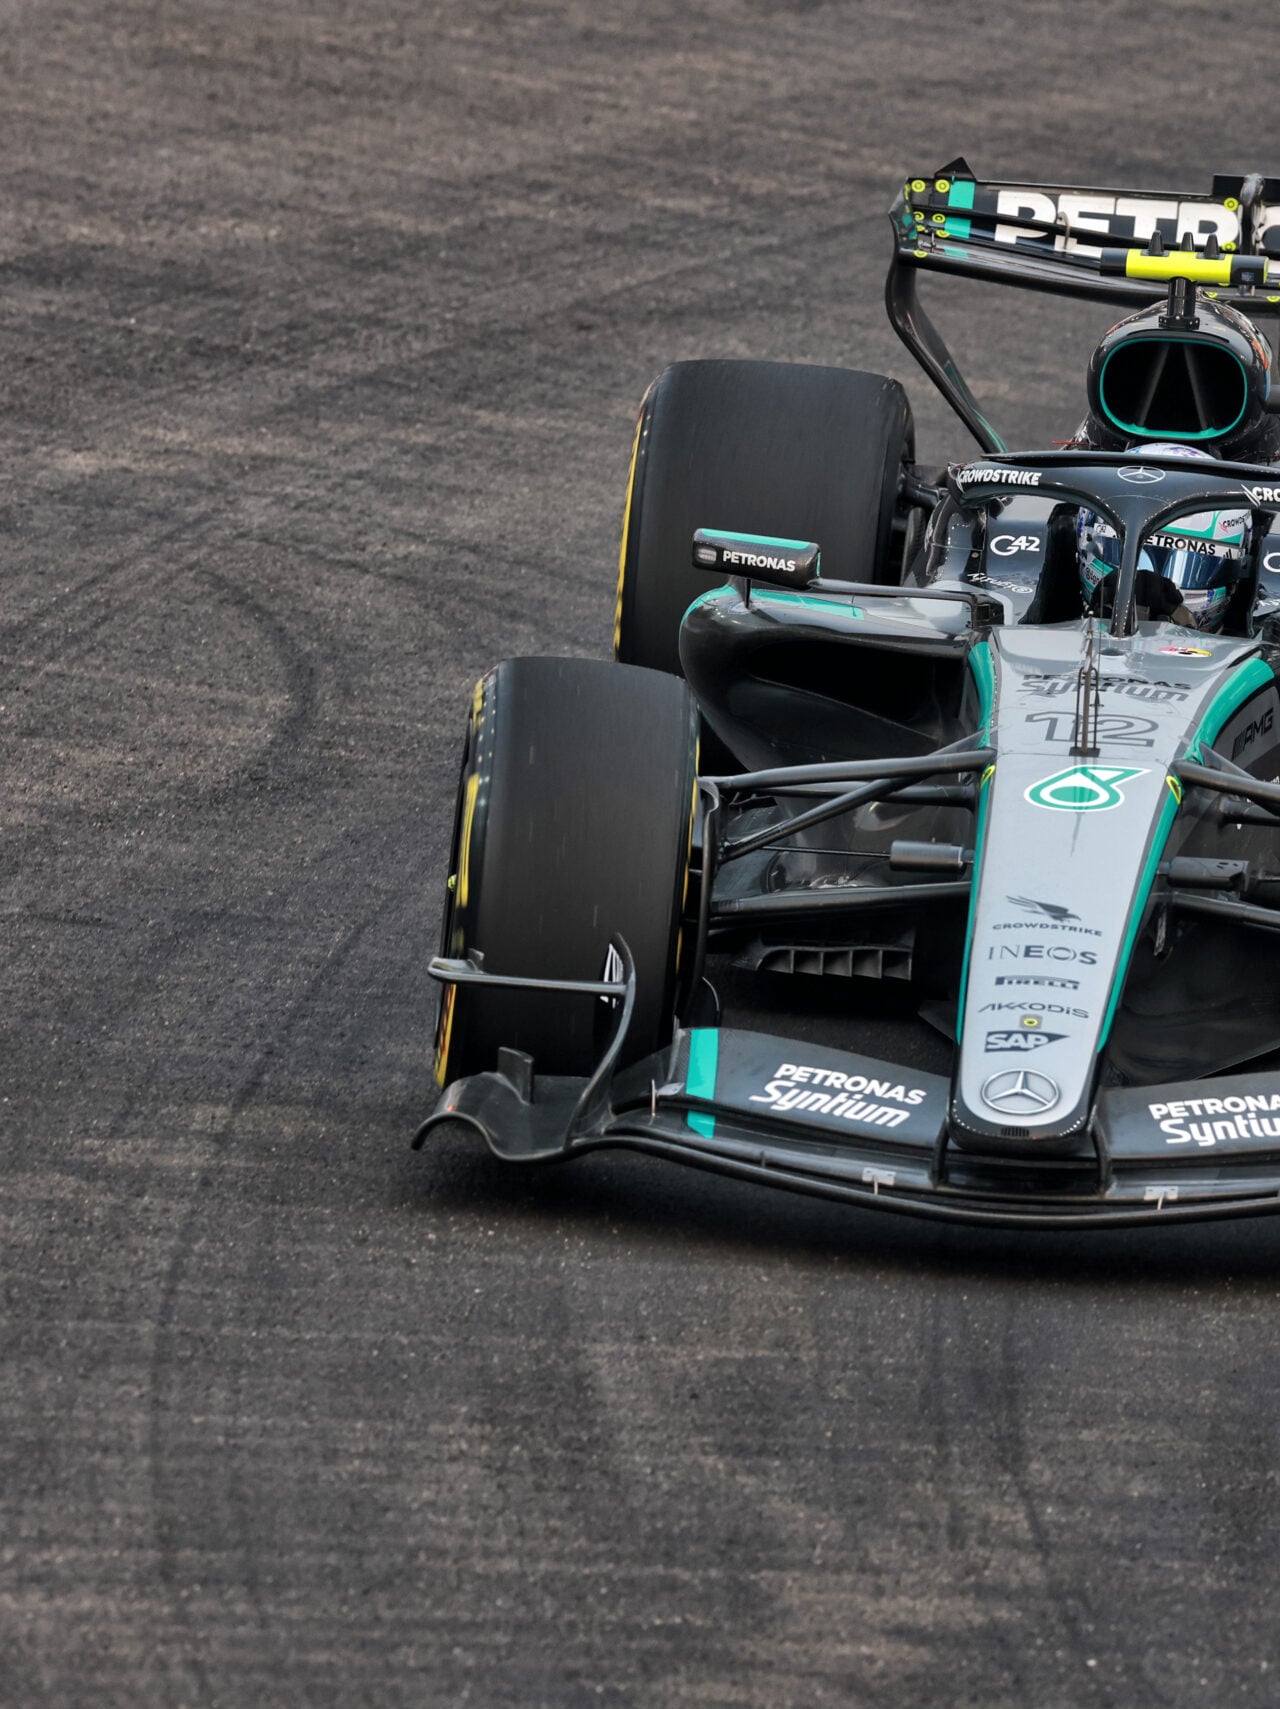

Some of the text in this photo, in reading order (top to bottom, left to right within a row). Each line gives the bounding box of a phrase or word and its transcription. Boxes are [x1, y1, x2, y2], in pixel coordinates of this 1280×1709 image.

[959, 469, 1042, 486] CROWDSTRIKE
[990, 535, 1040, 556] G42
[1145, 534, 1216, 556] ETRONAS
[723, 551, 796, 572] PETRONAS
[1025, 711, 1159, 748] 12
[992, 922, 1103, 937] CROWDSTRIKE
[988, 944, 1098, 966] INEOS
[995, 975, 1081, 990] PIRELLI
[986, 1033, 1049, 1050] SAP
[773, 1063, 927, 1105] PETRONAS
[749, 1079, 911, 1128] Syntium
